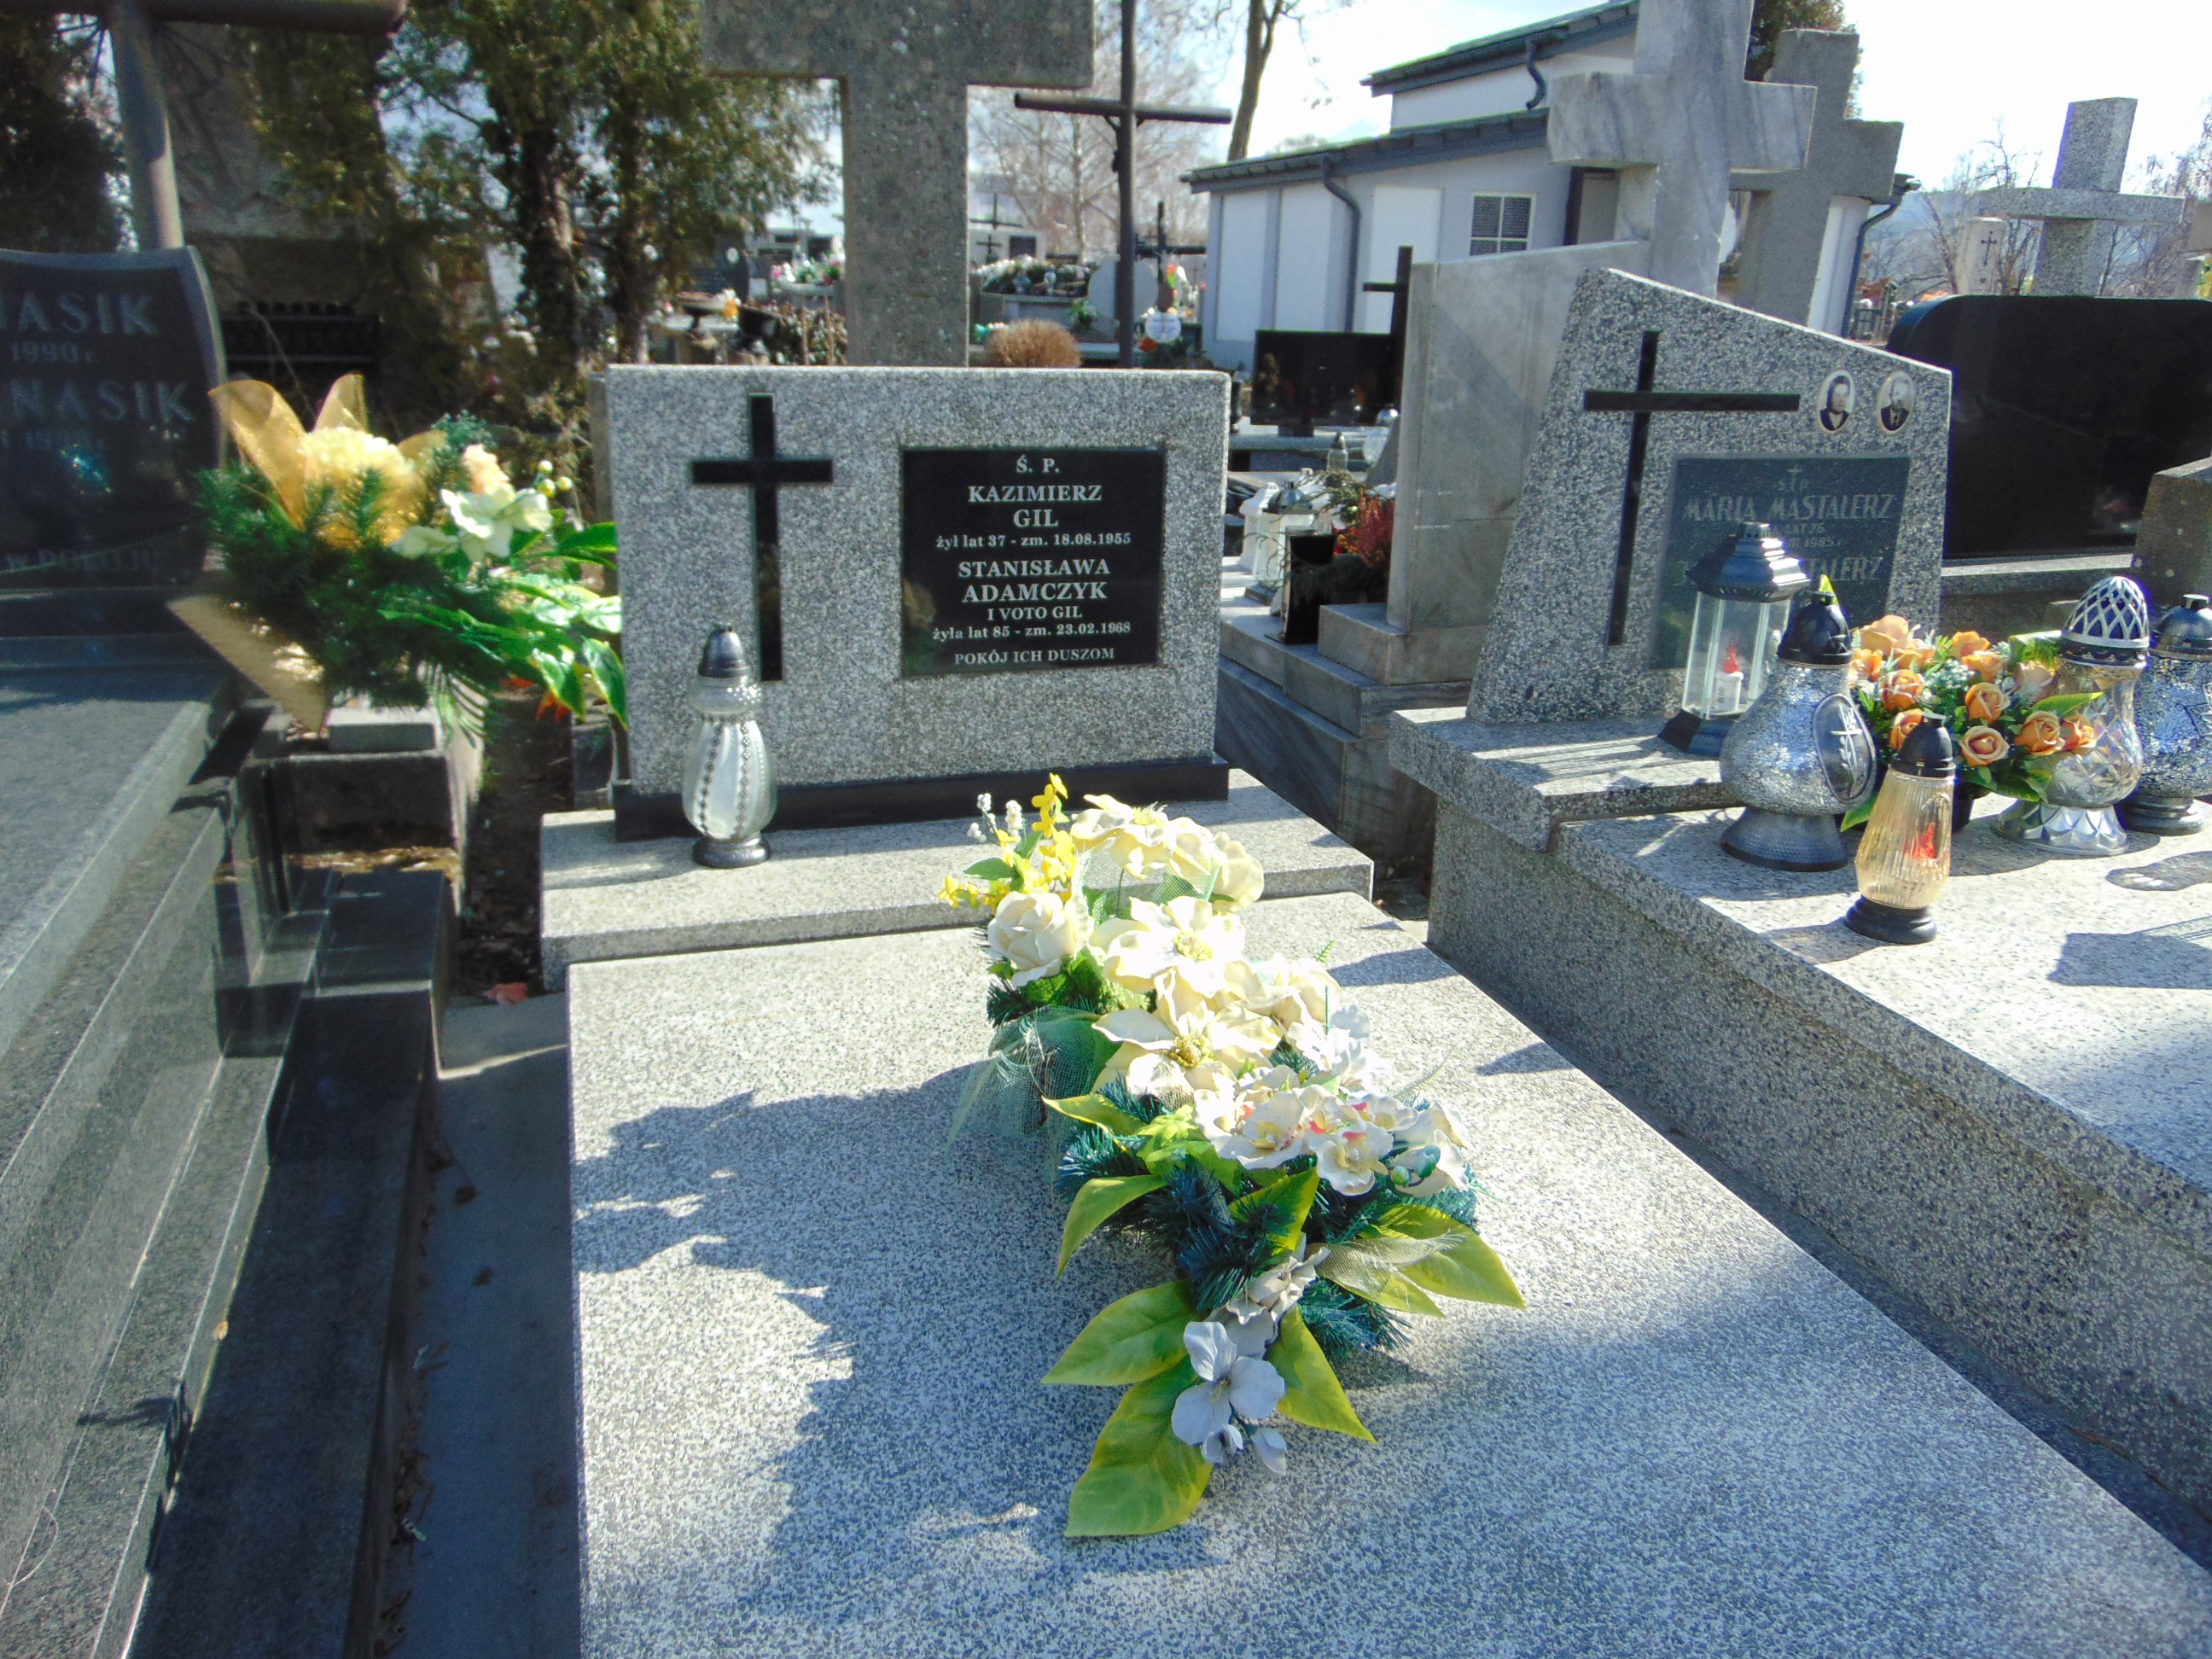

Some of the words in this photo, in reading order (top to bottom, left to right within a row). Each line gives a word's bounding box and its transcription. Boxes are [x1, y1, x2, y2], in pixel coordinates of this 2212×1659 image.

[0, 290, 160, 335] ASIK
[1042, 458, 1060, 473] P.
[969, 485, 1102, 503] KAZIMIERZ
[1684, 497, 1755, 521] MARIA
[1767, 494, 1896, 520] MASTALERZ
[1014, 509, 1058, 527] GIL
[936, 535, 958, 550] żył
[963, 535, 984, 547] lat
[988, 535, 1005, 546] 37
[1021, 536, 1048, 546] zm.
[1054, 533, 1131, 546] 18.08.1955
[958, 559, 1109, 577] STANISŁAWA
[1809, 556, 1884, 581] TALERZ
[962, 582, 1108, 602] ADAMCZYK
[987, 608, 993, 621] I
[1000, 607, 1047, 620] VOTO
[1052, 606, 1082, 618] GIL
[933, 626, 963, 642] żyła
[969, 626, 988, 638] lat
[993, 626, 1010, 637] 85
[1025, 626, 1051, 637] zm.
[1057, 623, 1131, 636] 23.02.1968
[955, 649, 1008, 665] POKÓJ
[1014, 649, 1042, 662] ICH
[1048, 648, 1115, 661] DUSZOM
